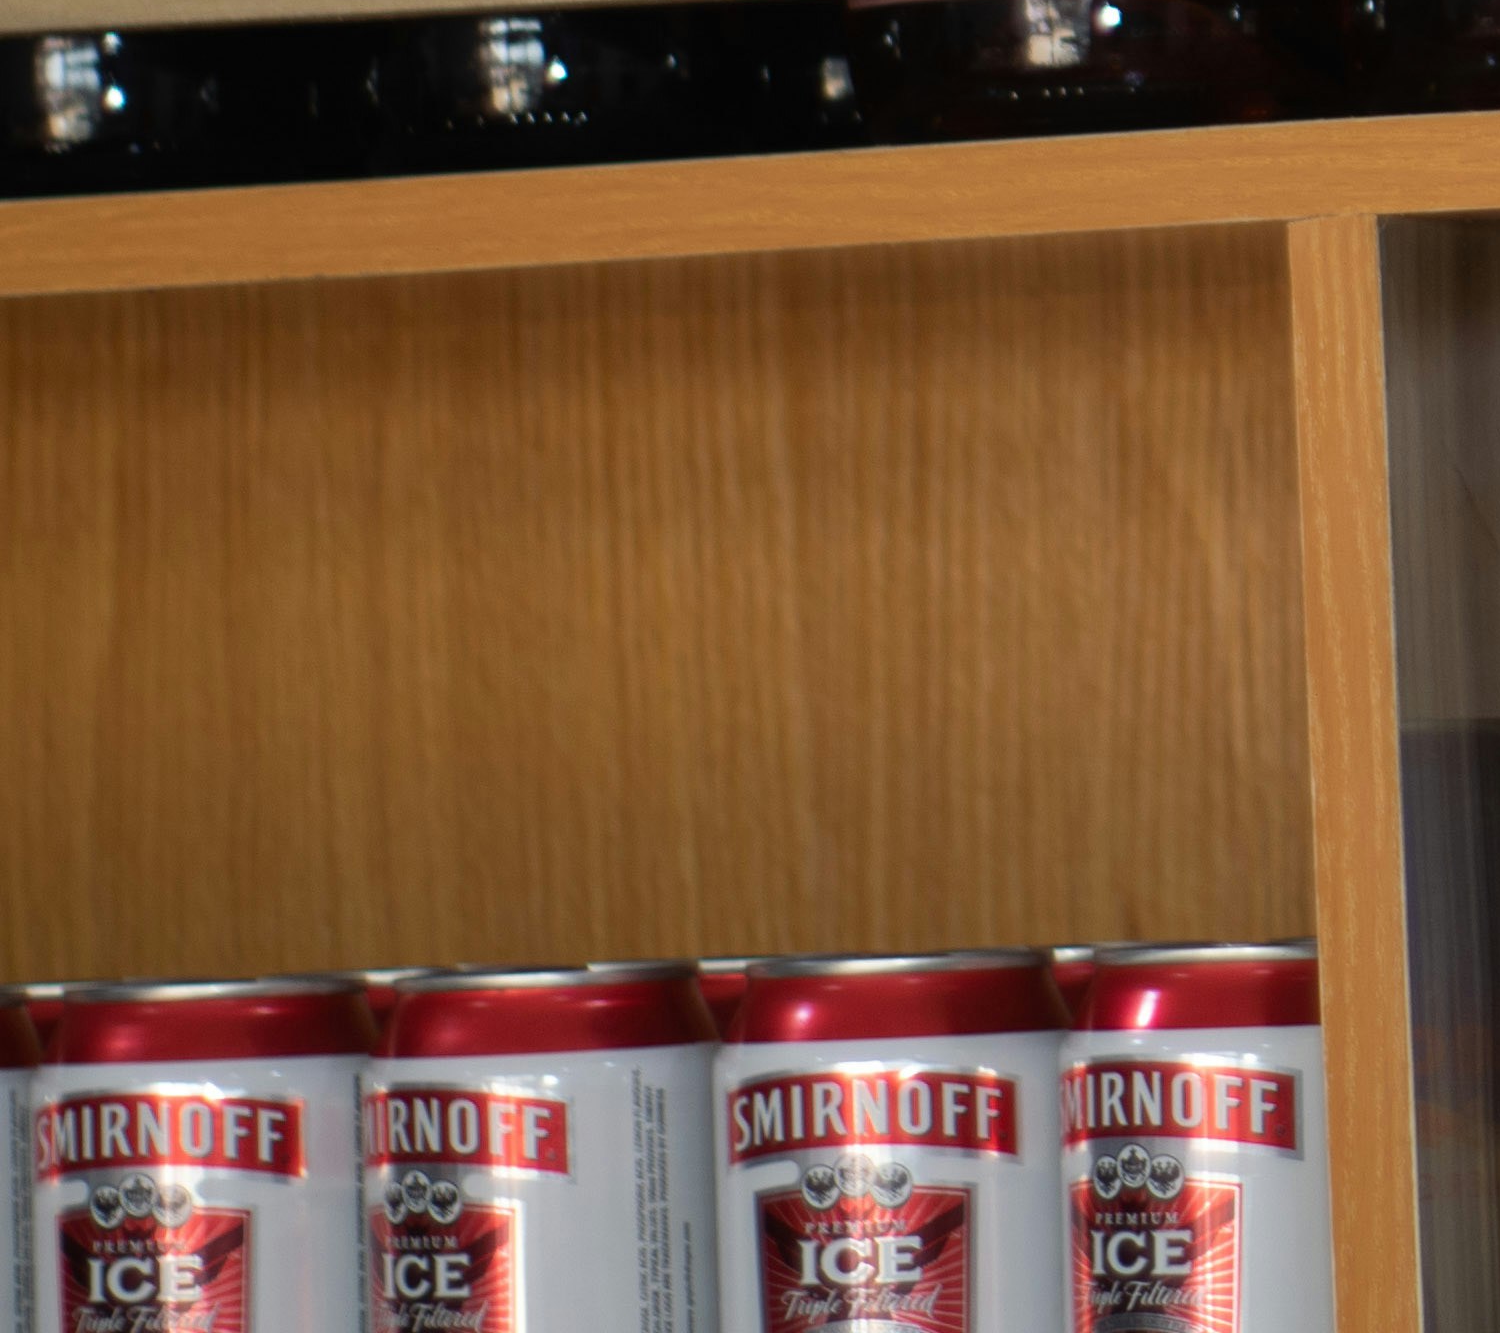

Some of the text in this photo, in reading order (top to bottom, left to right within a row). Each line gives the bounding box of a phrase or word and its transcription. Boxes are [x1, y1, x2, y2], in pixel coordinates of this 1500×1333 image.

[37, 1098, 286, 1165] SMIRNOFF
[734, 1080, 1003, 1152] SMIRNOFF
[804, 1219, 908, 1236] PREMIUM
[89, 1253, 202, 1304] ICE
[798, 1235, 922, 1286] ICE
